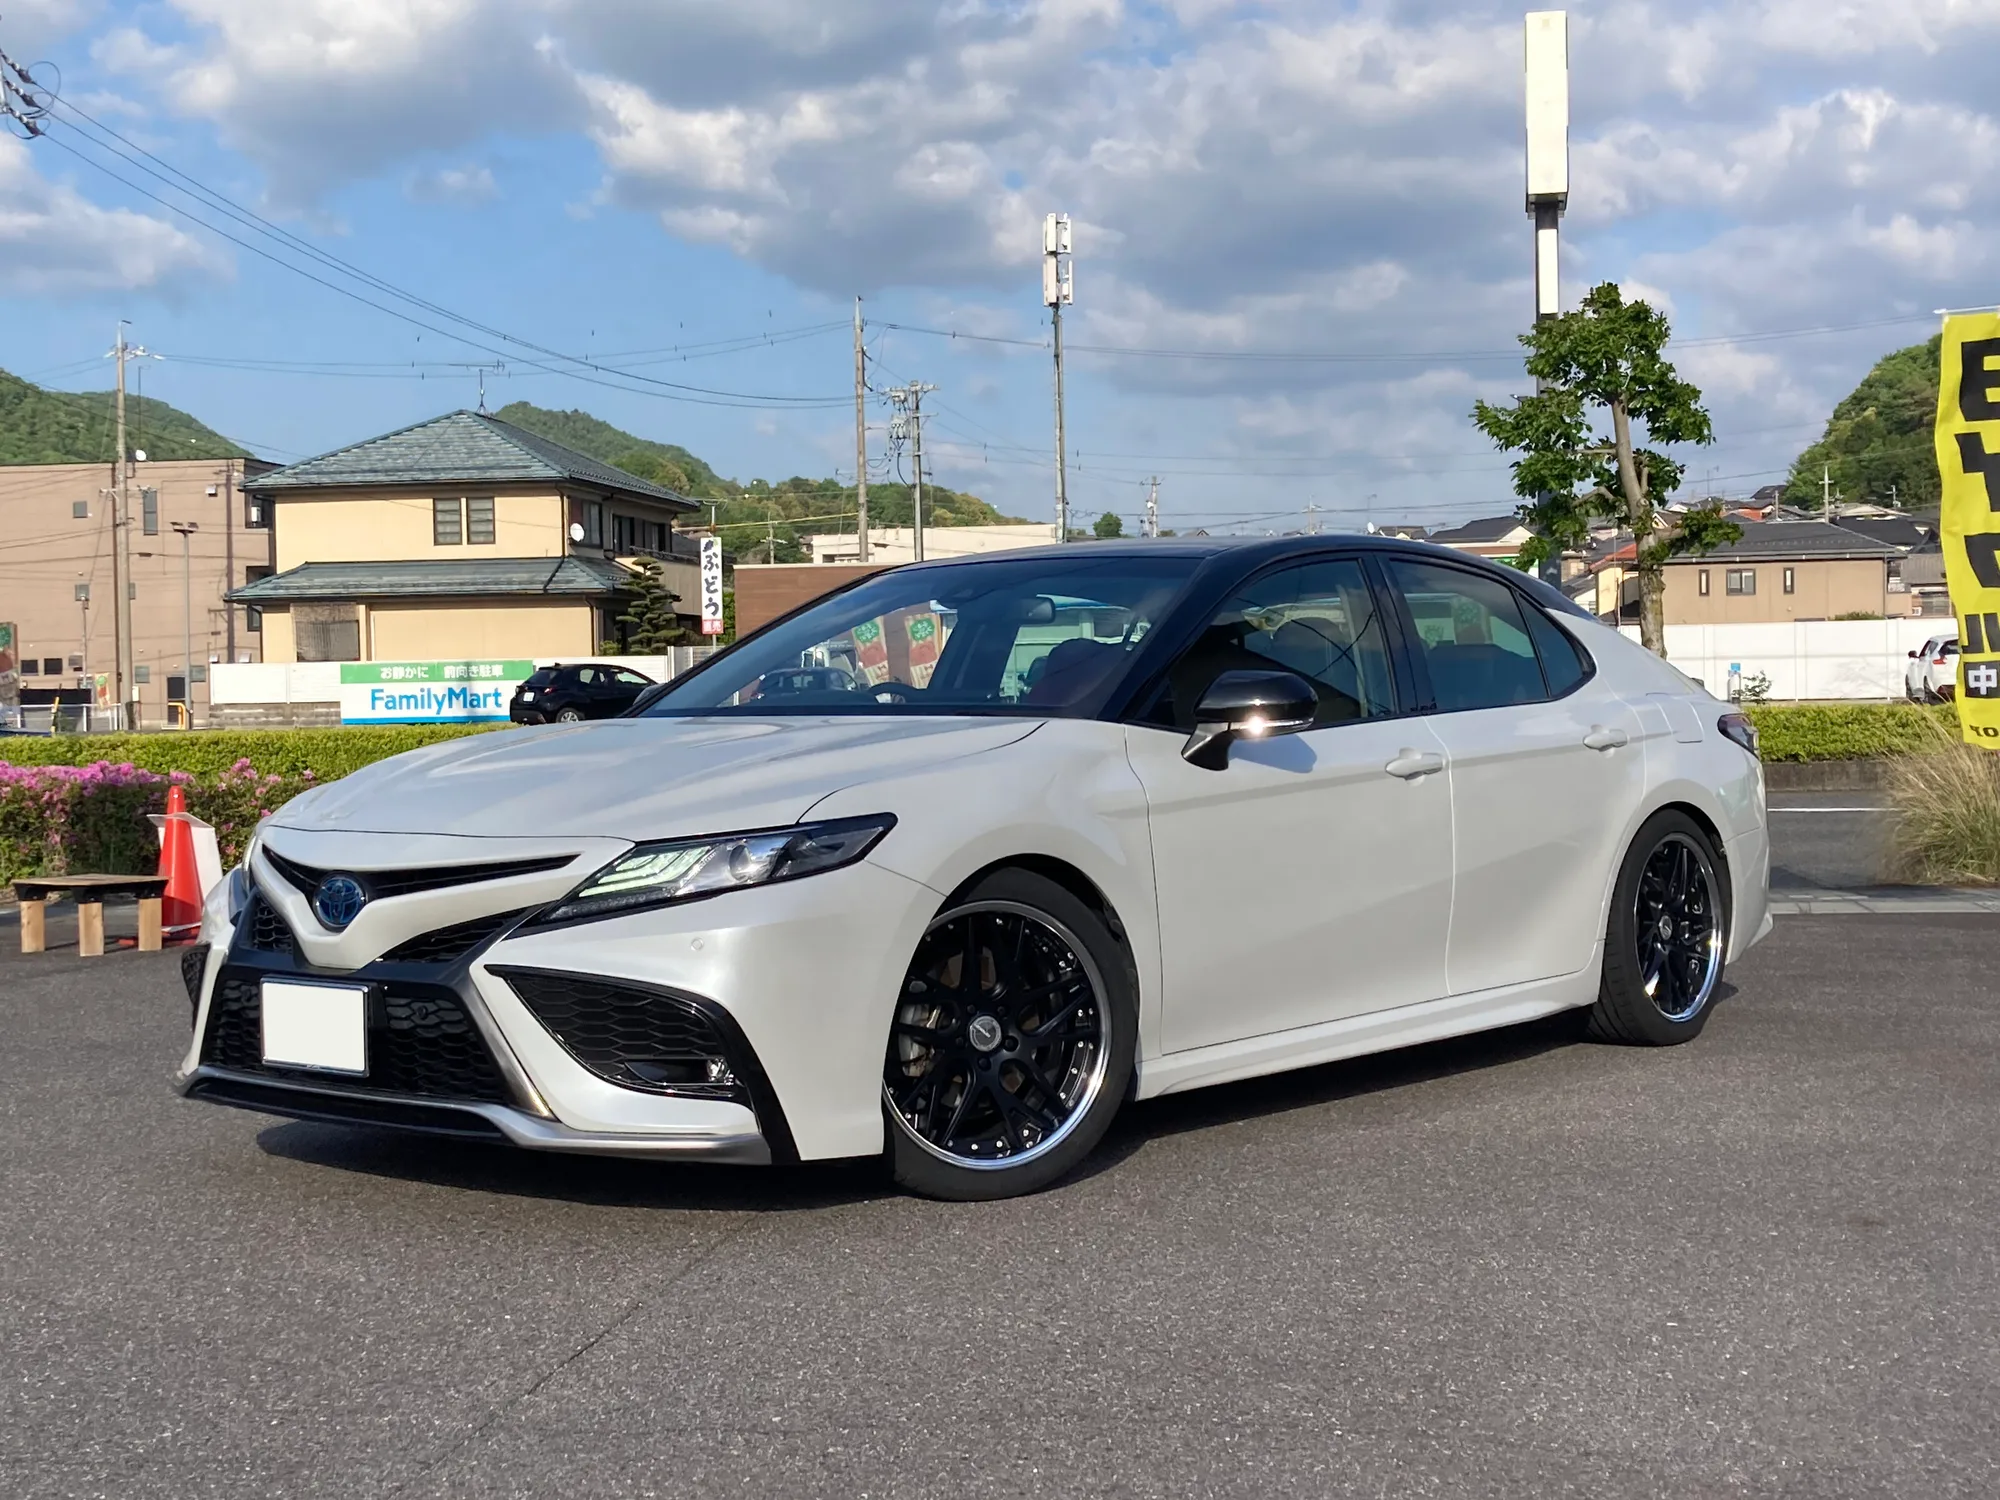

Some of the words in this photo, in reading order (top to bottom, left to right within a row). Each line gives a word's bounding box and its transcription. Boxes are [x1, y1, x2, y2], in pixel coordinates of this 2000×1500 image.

[381, 665, 429, 680] お静かに
[444, 664, 504, 679] 前向き駐車
[371, 687, 502, 714] FamilyMart
